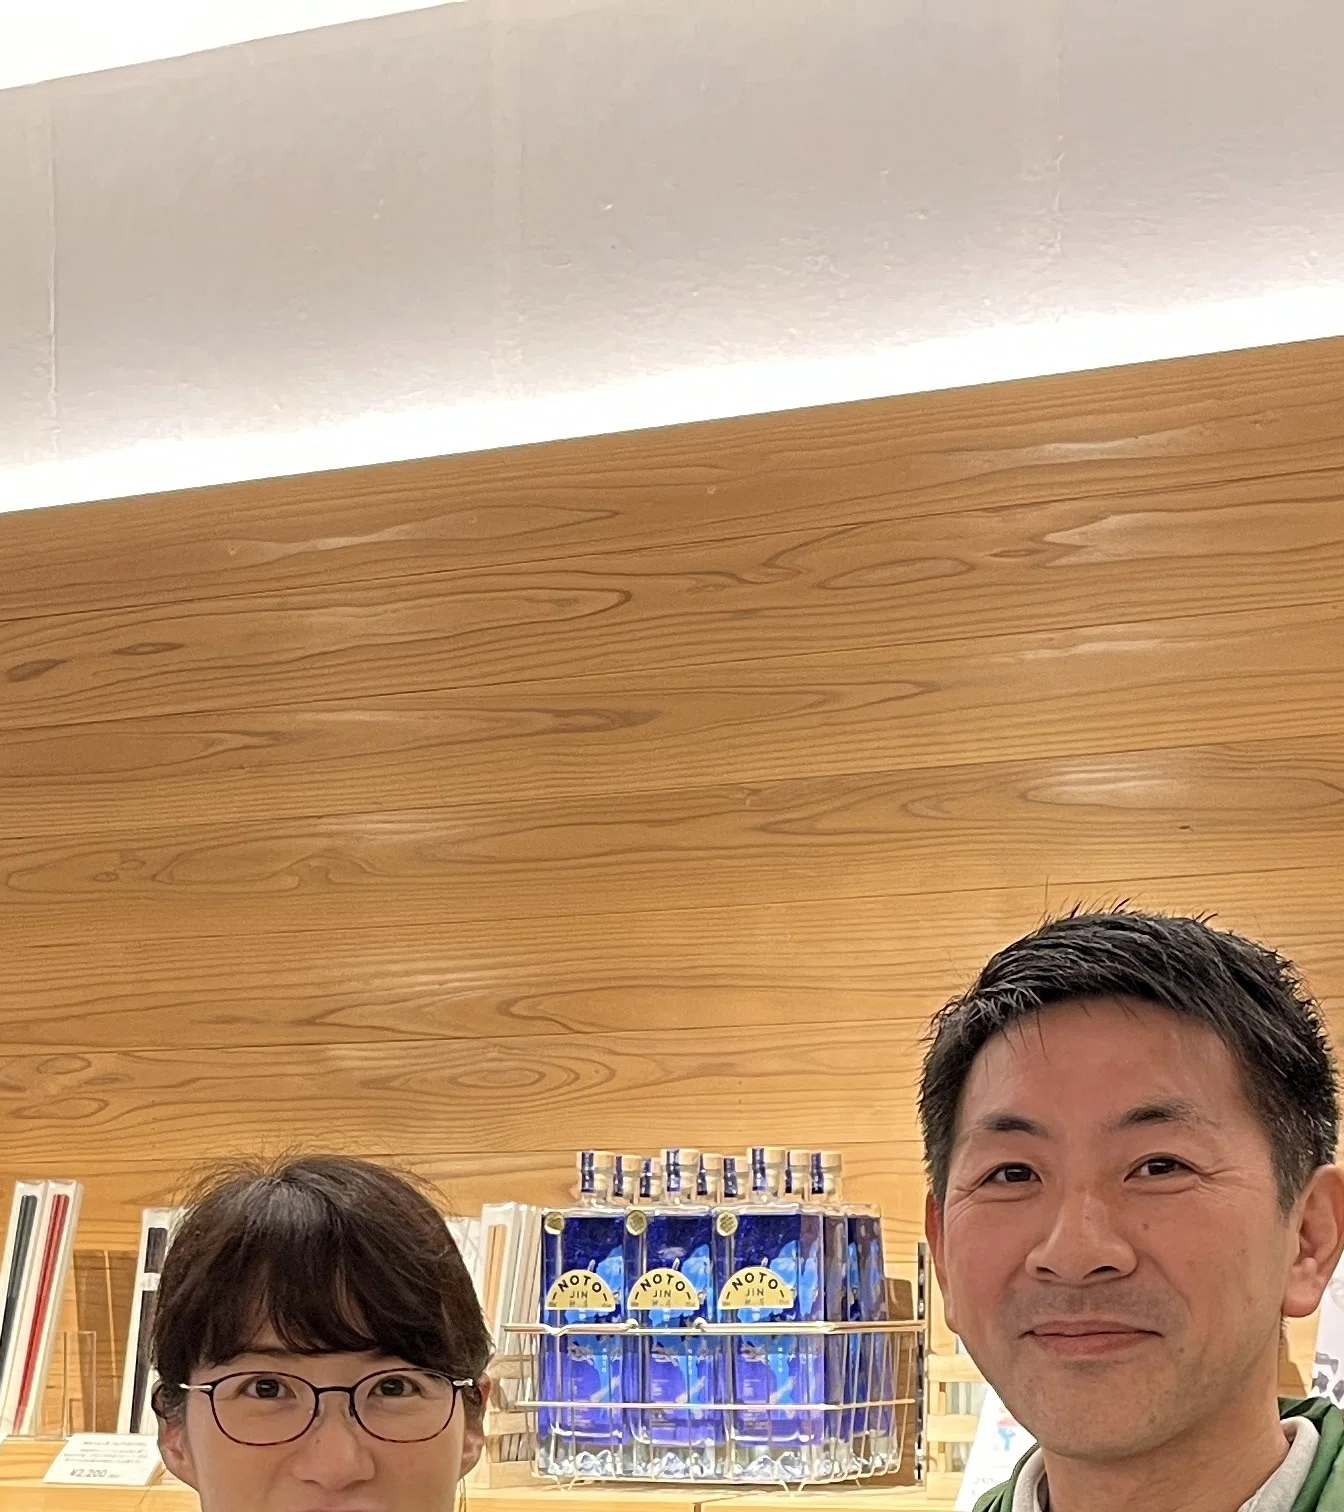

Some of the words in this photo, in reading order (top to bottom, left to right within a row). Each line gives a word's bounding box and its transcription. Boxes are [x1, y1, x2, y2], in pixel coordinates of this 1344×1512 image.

[558, 1274, 602, 1293] NOTO
[640, 1273, 686, 1292] NOTO
[732, 1272, 778, 1292] NOTO
[570, 1290, 588, 1300] JIN
[653, 1289, 671, 1299] JIN
[745, 1287, 764, 1298] JIN
